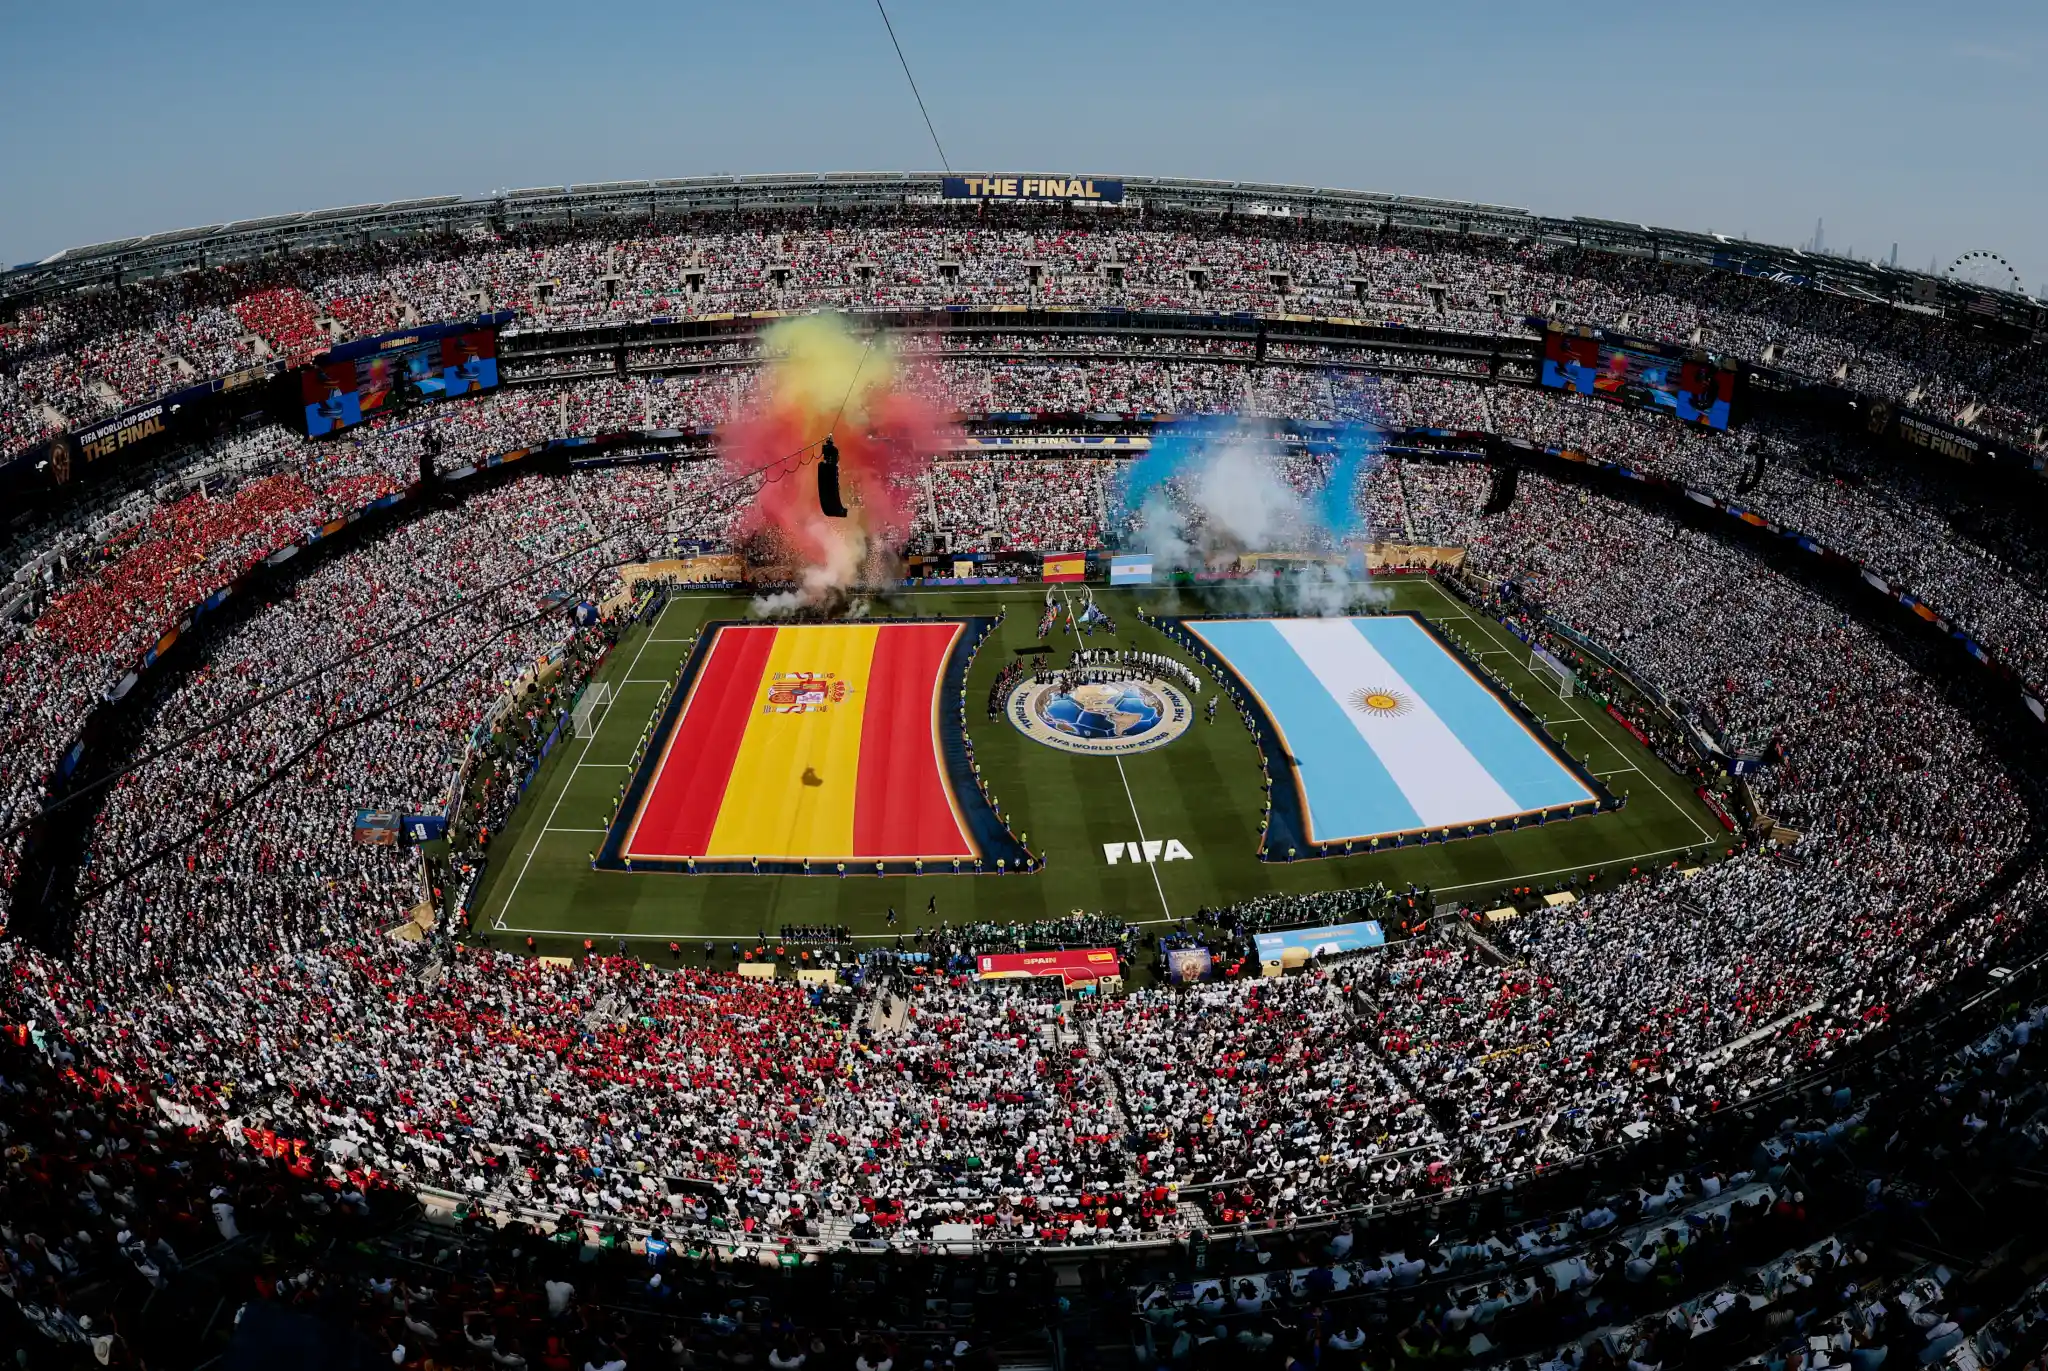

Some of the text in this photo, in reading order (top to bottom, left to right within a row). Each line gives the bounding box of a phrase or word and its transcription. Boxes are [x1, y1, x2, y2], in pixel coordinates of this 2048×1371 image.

[965, 178, 1101, 198] THE FINAL
[80, 405, 163, 446] FIFA WORLD CUP 2026
[82, 416, 166, 463] THE FINAL
[1899, 424, 1930, 448] THE
[1900, 415, 1979, 451] FIFA WORLD CUP 2026
[1015, 691, 1035, 730] THE FINAL
[1161, 686, 1184, 723] THE FINAL
[1047, 731, 1170, 751] FIFA WORLD CUP 2026
[1103, 839, 1194, 865] FIFA
[1023, 957, 1057, 965] SPAIN
